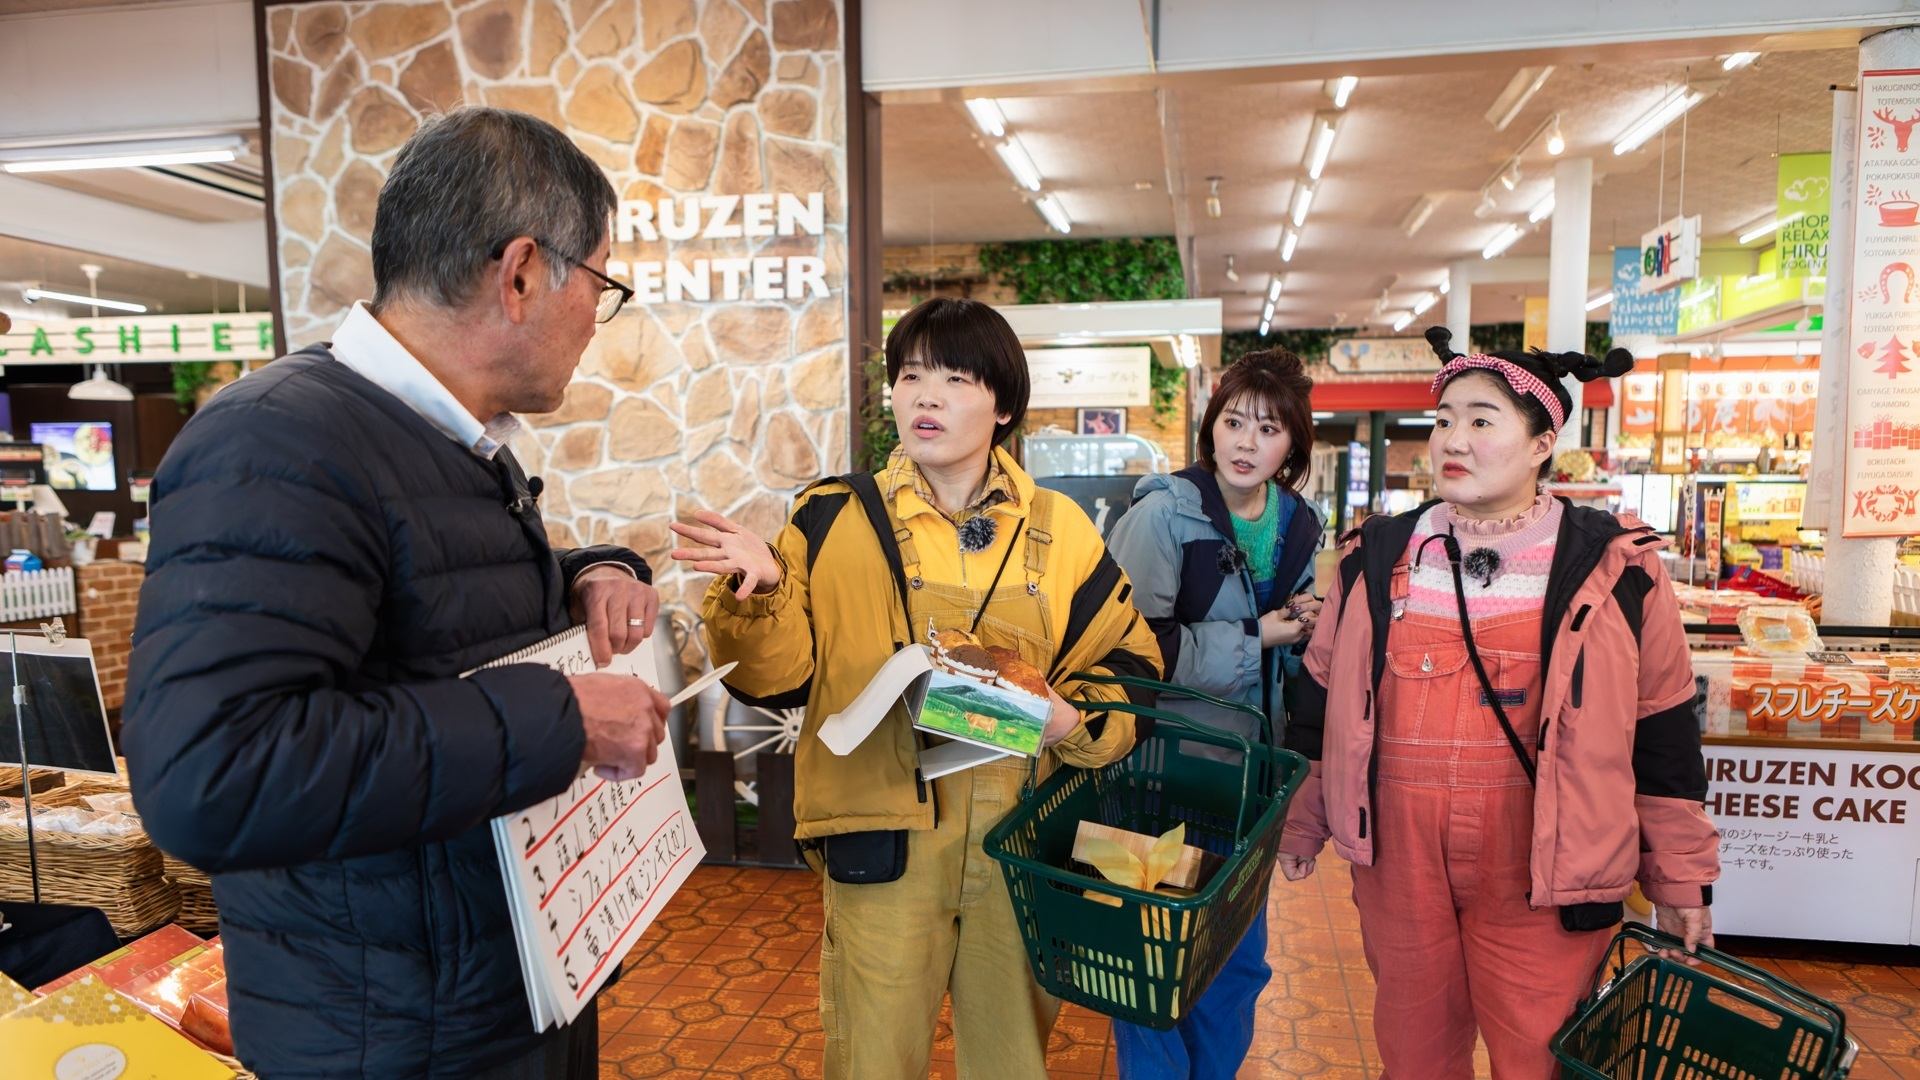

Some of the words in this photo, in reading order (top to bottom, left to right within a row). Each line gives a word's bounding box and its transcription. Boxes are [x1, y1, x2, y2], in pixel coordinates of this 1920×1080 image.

[1864, 159, 1898, 168] ATATAKA
[609, 192, 824, 243] RUZEN
[1865, 235, 1897, 244] FUYUNO
[1863, 248, 1896, 257] SOTOWA
[1863, 324, 1895, 334] TOTEMO
[0, 323, 275, 356] ASHIER
[1856, 386, 1890, 396] OMIYAGE
[1870, 400, 1910, 409] OKAIMONO
[1866, 457, 1906, 466] BOKUTACHI
[1857, 470, 1885, 479] FUYUGA
[1886, 470, 1914, 478] DAISUKI
[1812, 796, 1907, 824] CAKE
[522, 817, 536, 849] 2
[533, 865, 547, 899] 3
[548, 911, 562, 946] 4
[564, 955, 578, 991] 5
